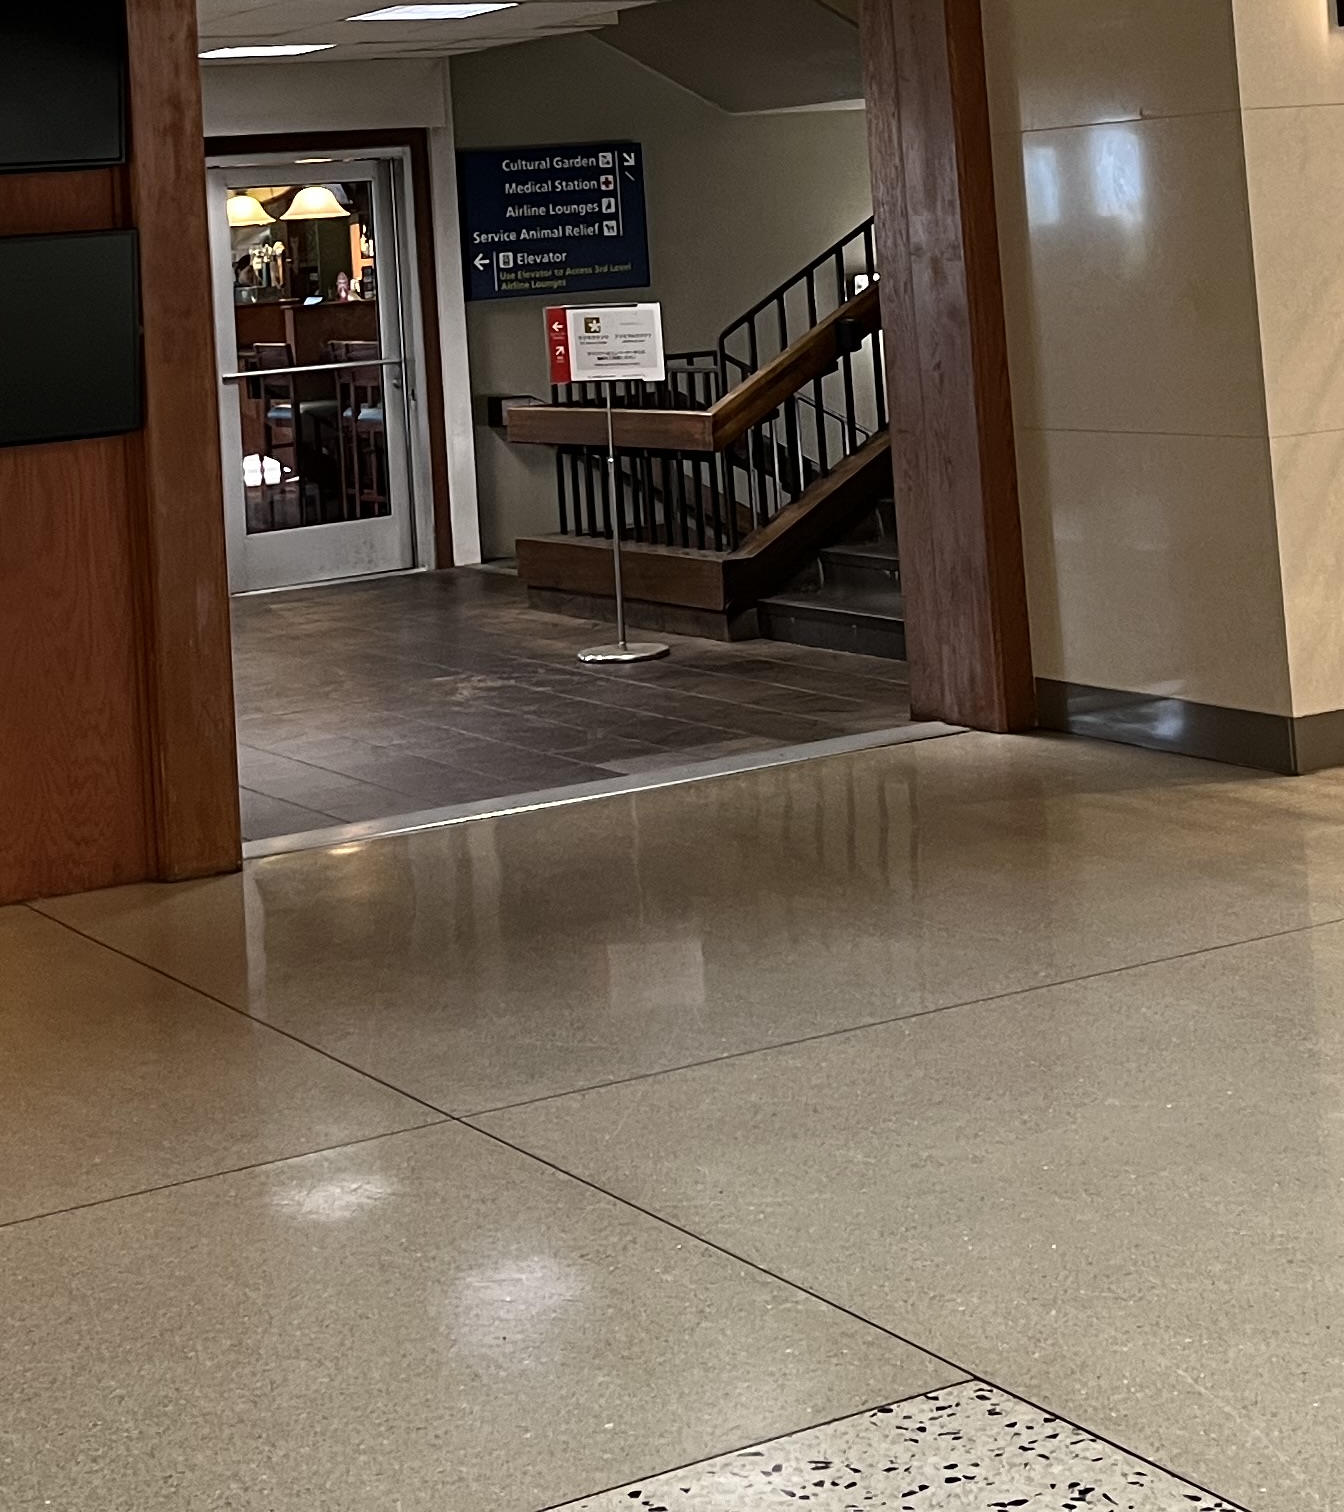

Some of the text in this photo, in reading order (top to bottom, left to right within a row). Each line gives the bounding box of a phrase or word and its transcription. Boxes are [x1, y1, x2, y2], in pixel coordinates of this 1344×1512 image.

[502, 155, 596, 172] Cultural Garden
[505, 178, 598, 194] Medical Station
[506, 202, 599, 218] Airline Lounges
[473, 223, 599, 244] Service Animal Relief
[517, 251, 567, 265] Elevator
